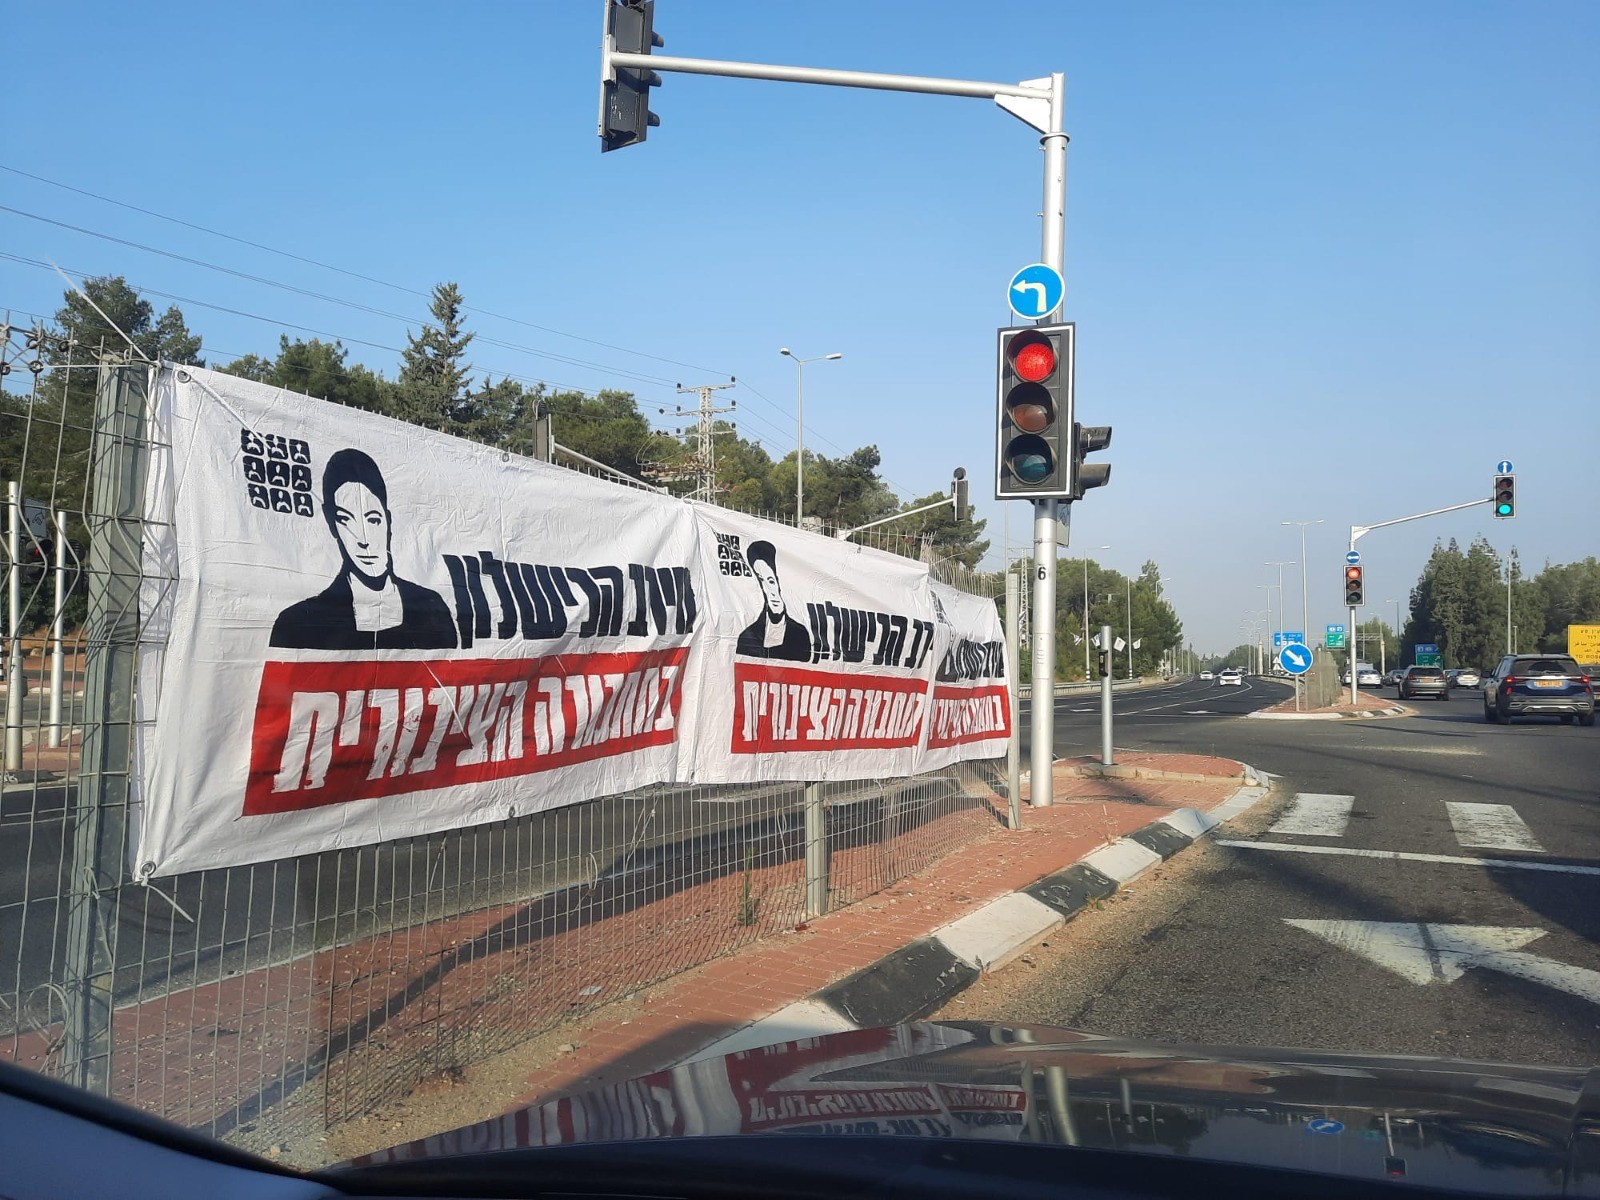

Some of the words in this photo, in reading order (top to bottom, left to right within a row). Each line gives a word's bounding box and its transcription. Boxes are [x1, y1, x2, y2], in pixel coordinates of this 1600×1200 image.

[441, 550, 623, 650] הכישלון
[627, 563, 697, 637] מירב
[1037, 566, 1047, 581] 6
[806, 600, 909, 667] הכישלון
[271, 680, 528, 793] הציבורית
[534, 665, 679, 756] בתחבורה
[742, 681, 847, 742] הציבורית
